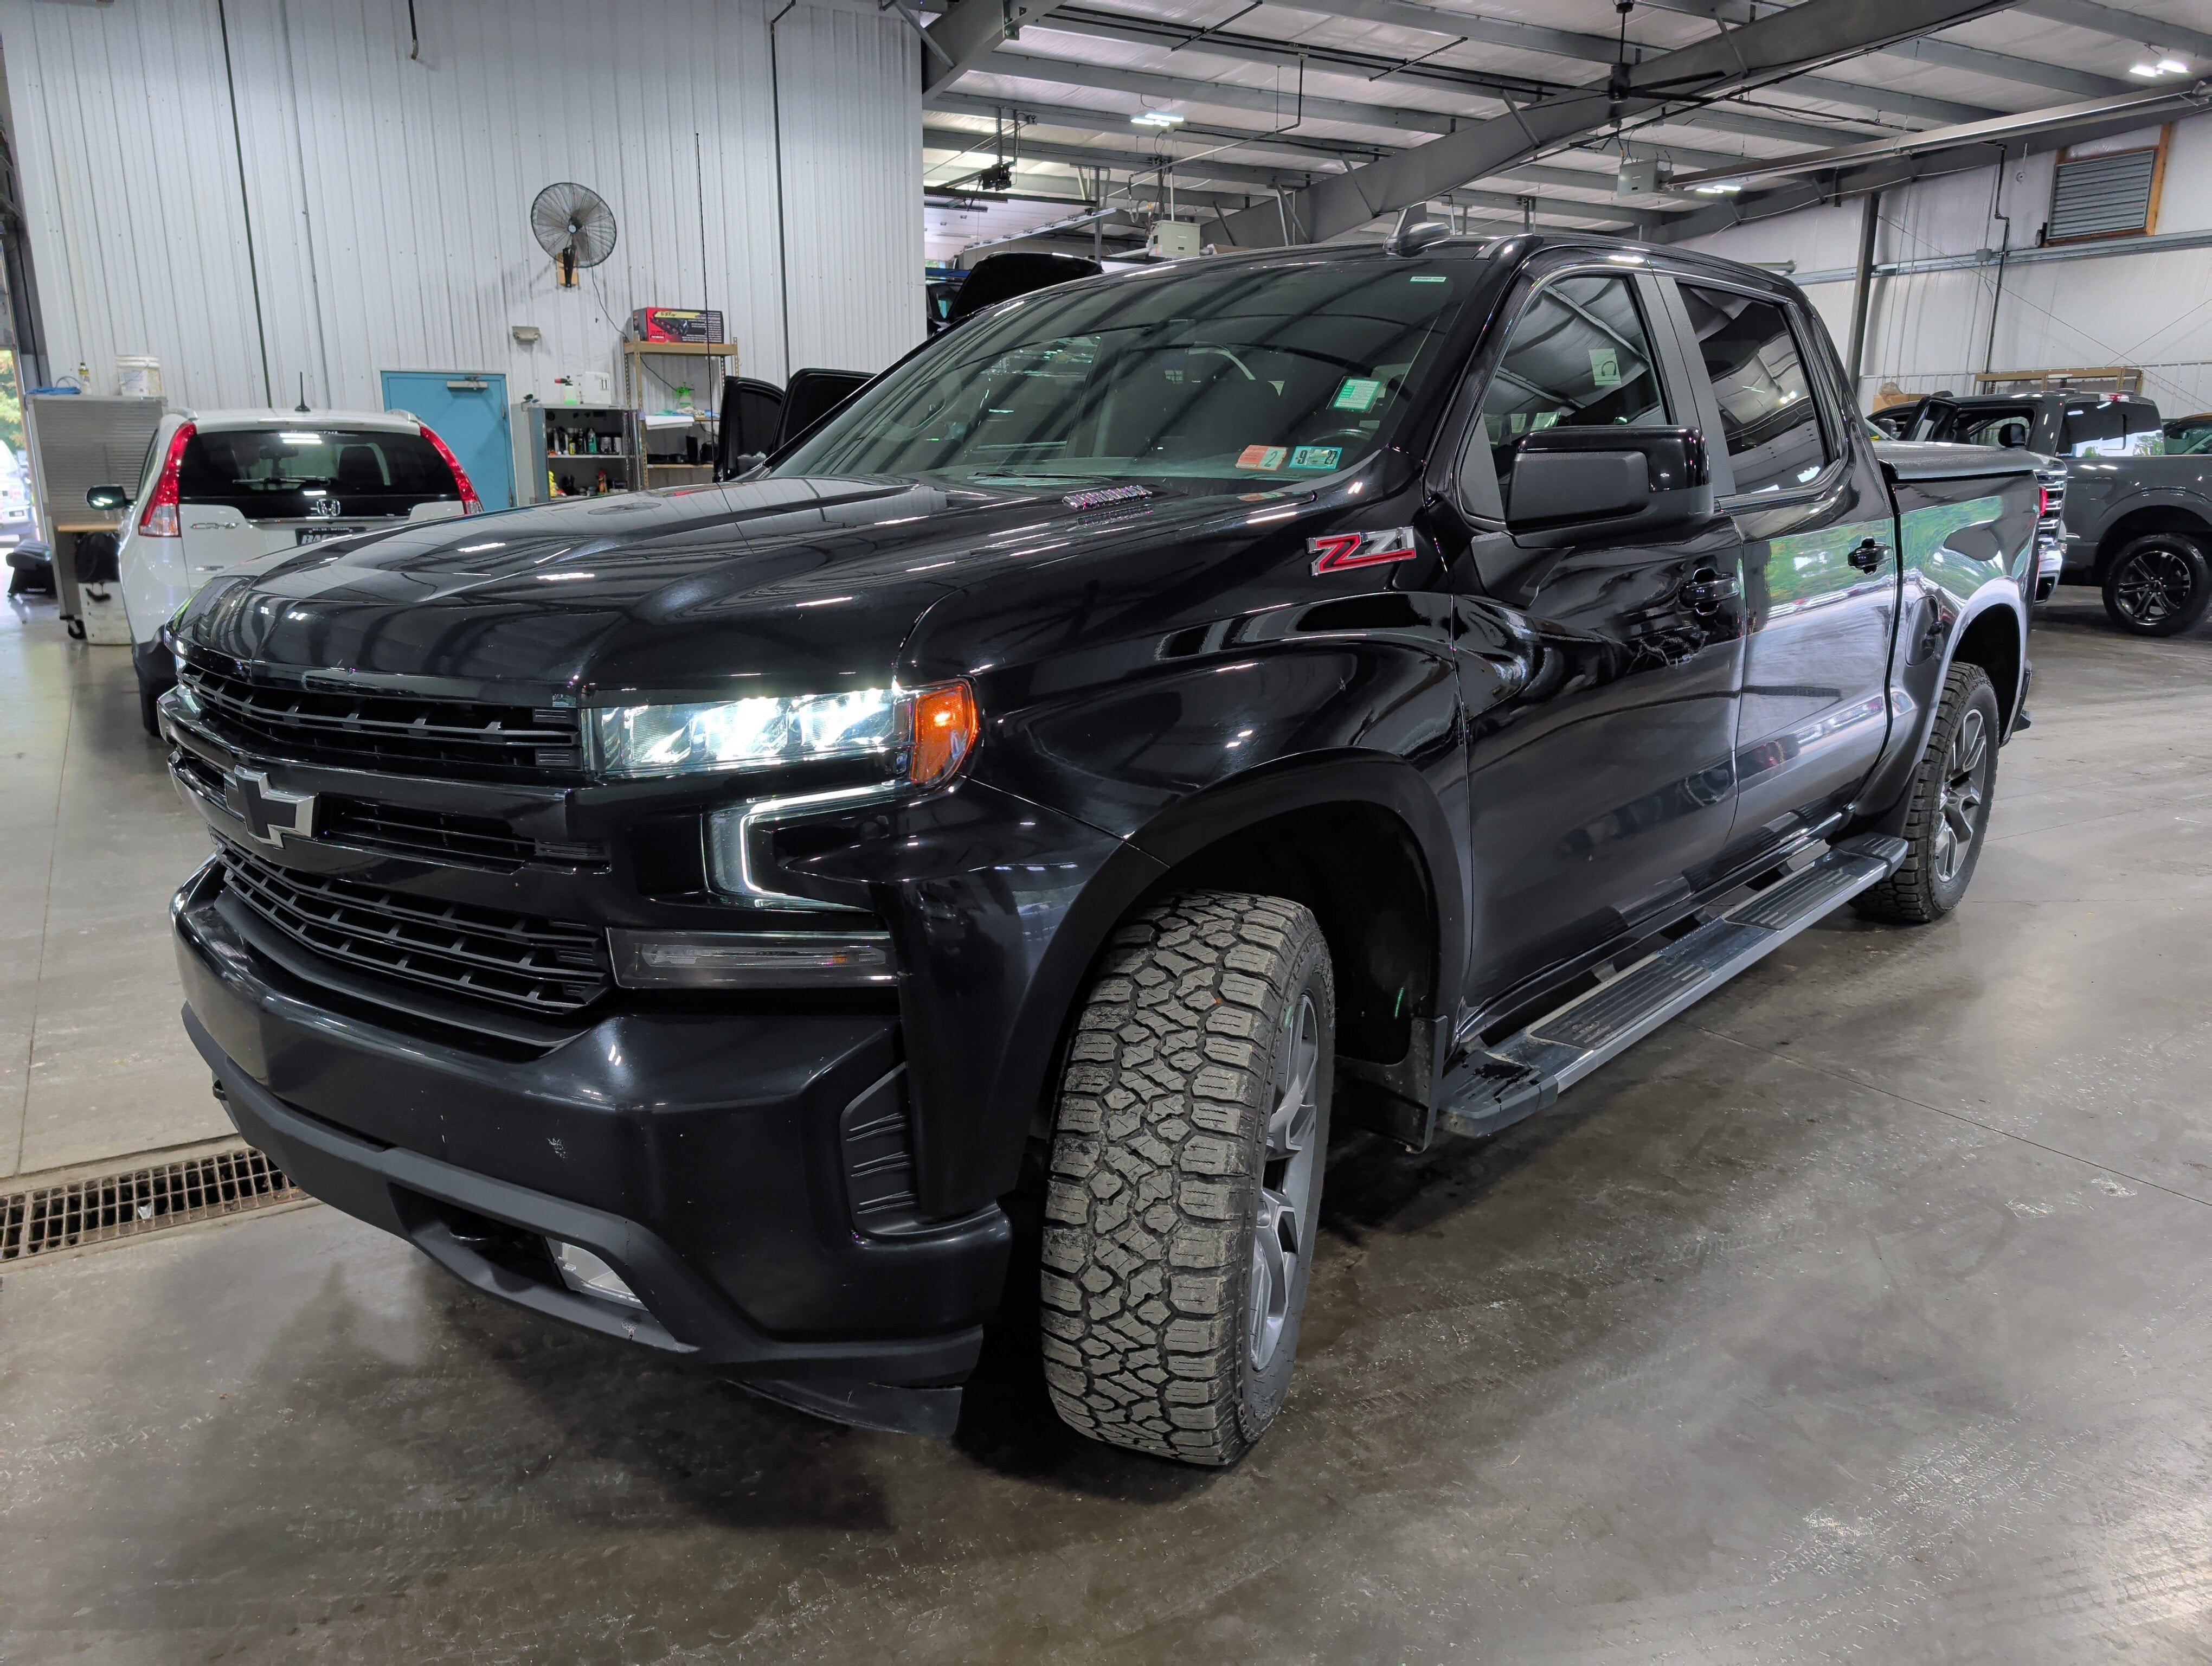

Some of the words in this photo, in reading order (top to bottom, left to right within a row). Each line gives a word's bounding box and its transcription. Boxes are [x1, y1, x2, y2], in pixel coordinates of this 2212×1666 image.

[1264, 450, 1278, 467] 2
[1297, 450, 1308, 464] 9
[1324, 450, 1339, 465] 27
[1306, 526, 1417, 576] Z71
